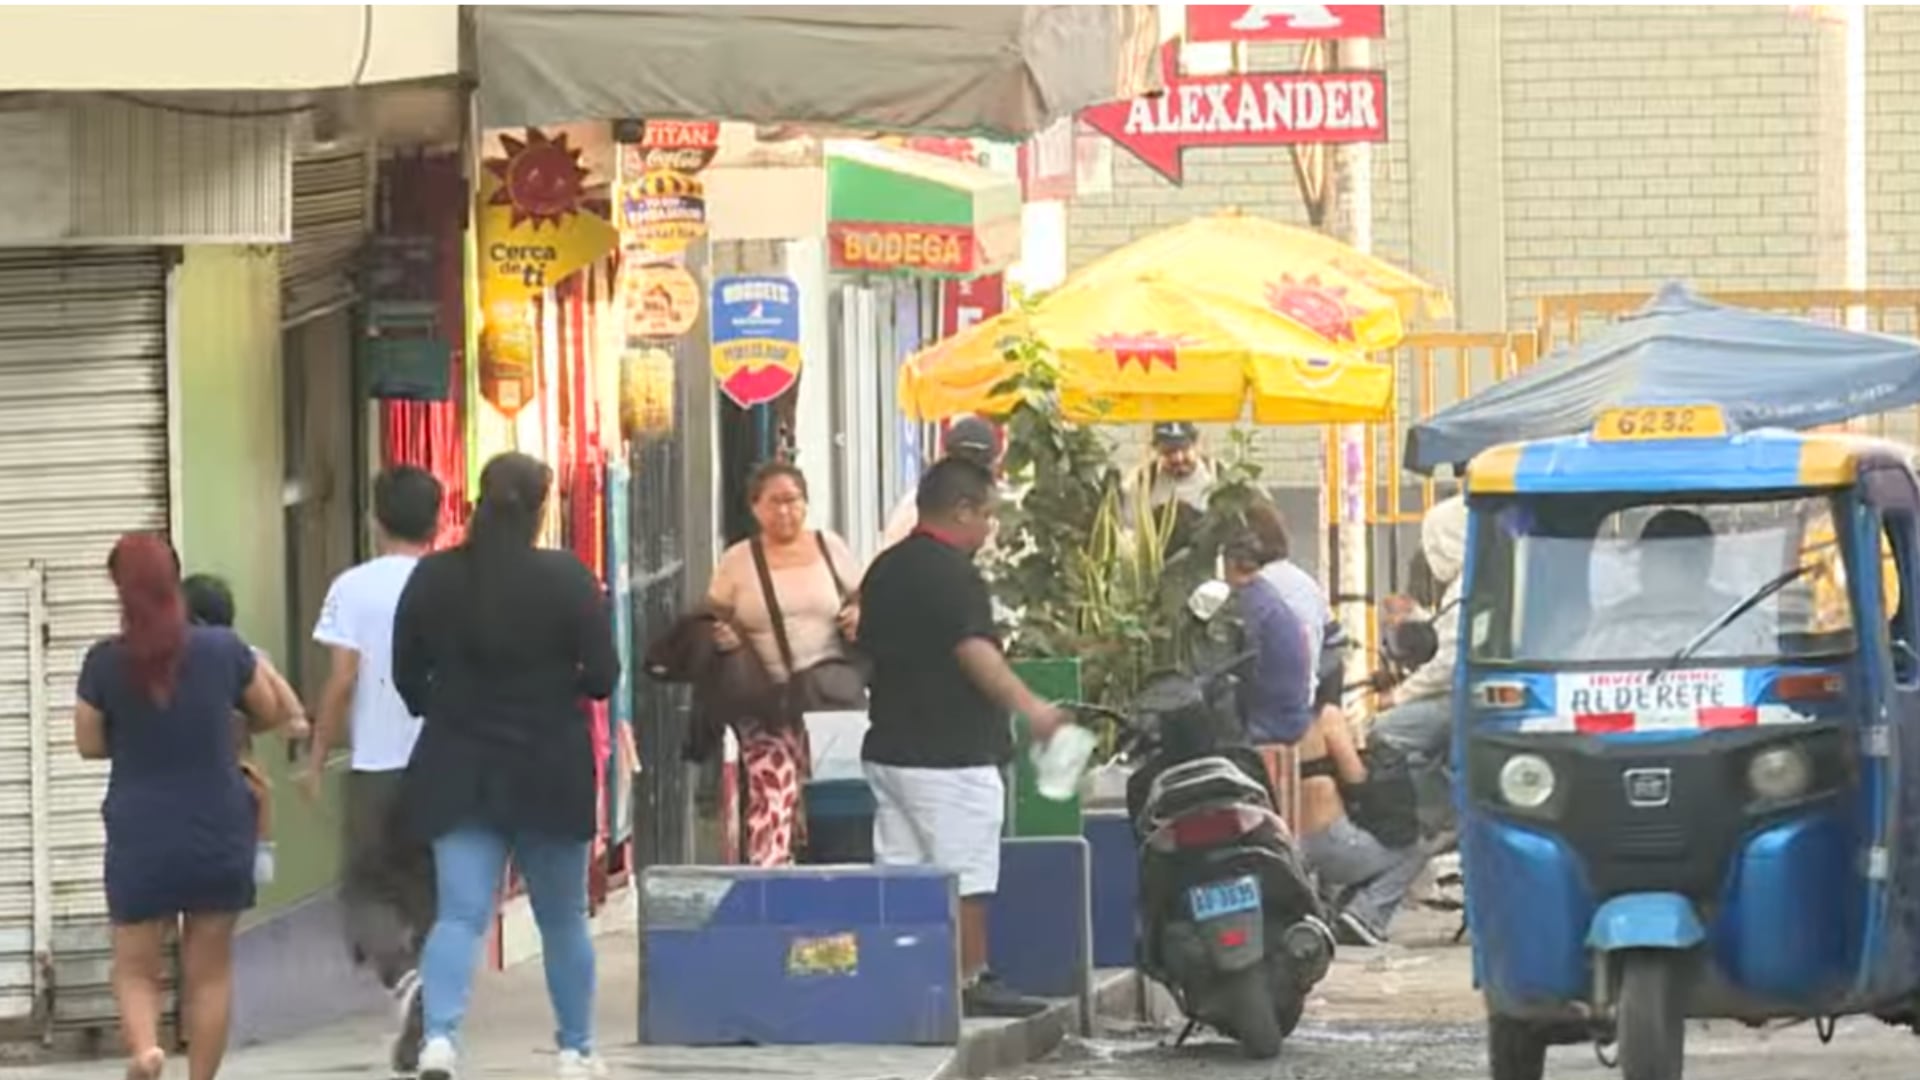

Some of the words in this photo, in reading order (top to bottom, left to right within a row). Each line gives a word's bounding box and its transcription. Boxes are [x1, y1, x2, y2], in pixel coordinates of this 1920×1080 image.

[1123, 80, 1379, 134] ALEXANDER
[489, 242, 558, 262] Cerca
[842, 231, 962, 264] BODEGA
[522, 262, 547, 287] ti
[1616, 408, 1696, 436] 6232
[1571, 682, 1725, 717] ALDERETE
